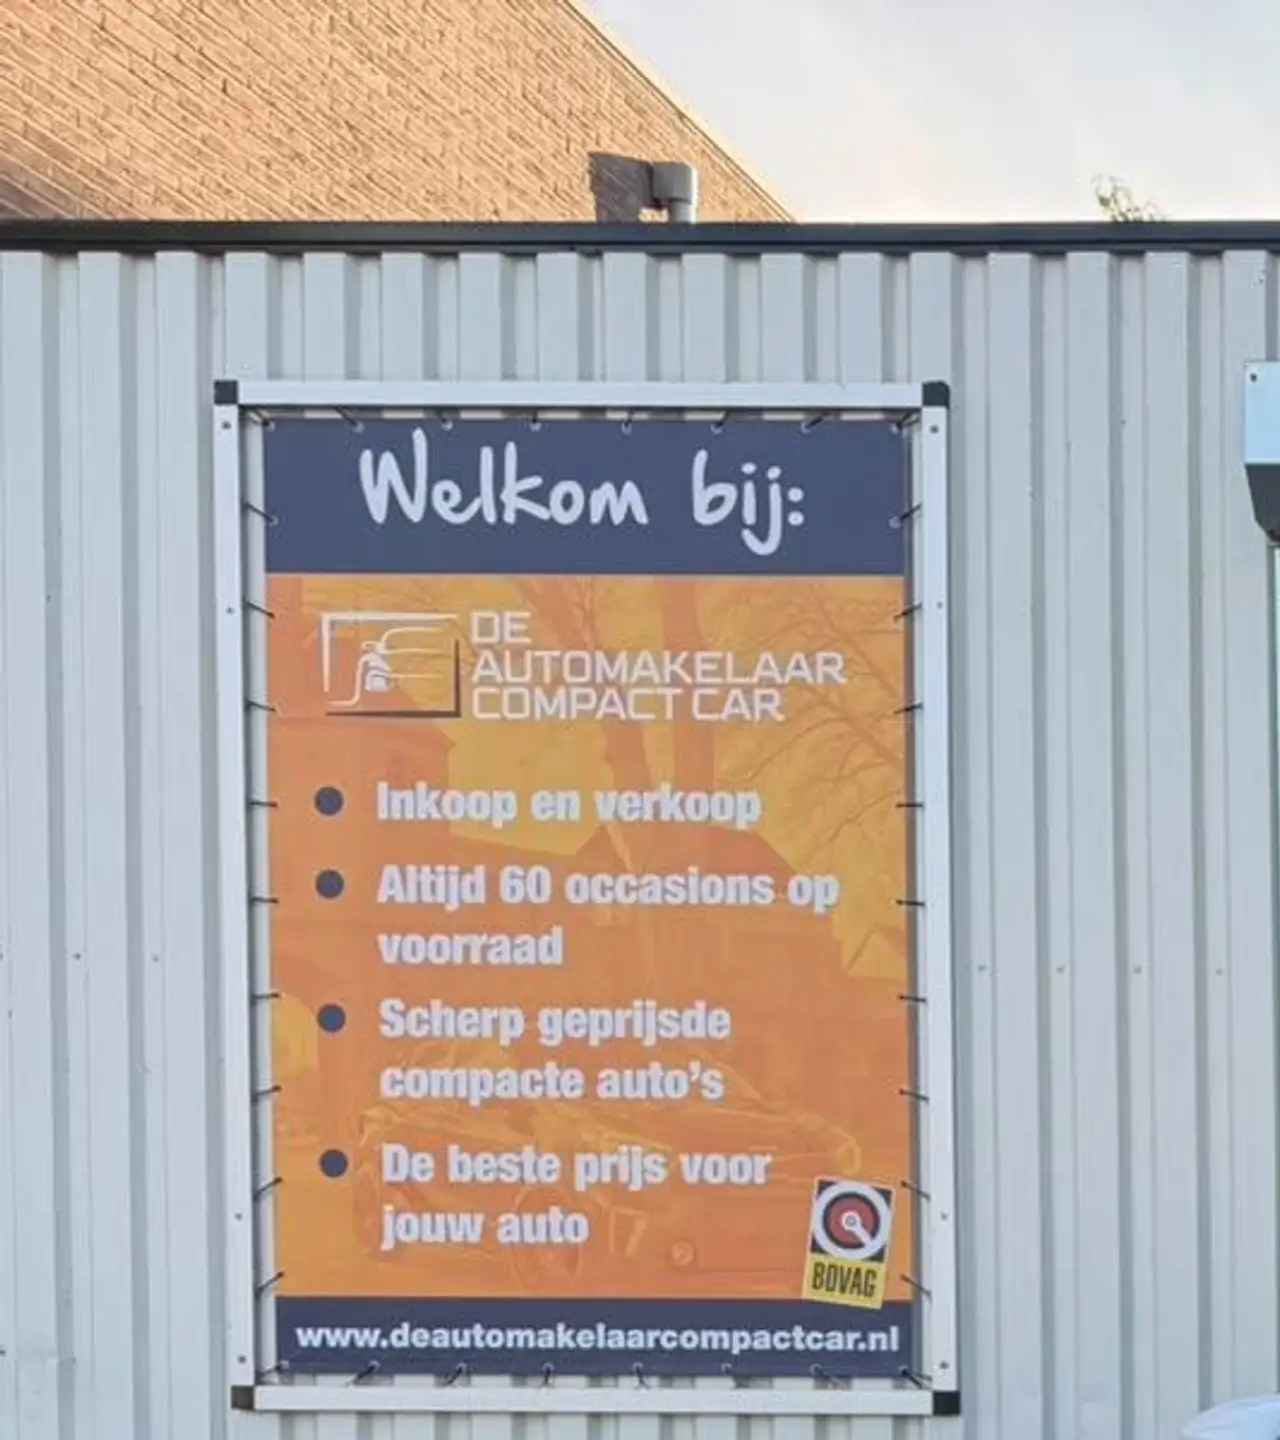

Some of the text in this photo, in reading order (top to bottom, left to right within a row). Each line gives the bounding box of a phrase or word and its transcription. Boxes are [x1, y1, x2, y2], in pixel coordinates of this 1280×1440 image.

[360, 428, 804, 555] Welkom bij:
[471, 612, 531, 644] DE
[472, 650, 847, 686] AUTOMAKELAAR
[473, 686, 783, 721] COMPACT CAR
[378, 782, 761, 829] Inkoop en verkoop
[378, 865, 840, 914] Altijd 60 occasions op
[379, 927, 563, 965] voorraad
[380, 998, 730, 1046] Scherp geprijsde
[381, 1062, 724, 1107] compacte auto's
[383, 1144, 772, 1191] De beste prijs voor
[382, 1206, 589, 1250] jouw auto
[811, 1259, 878, 1299] BOVAG
[296, 1322, 898, 1354] www.deautomakelaarcompactcar.nl
